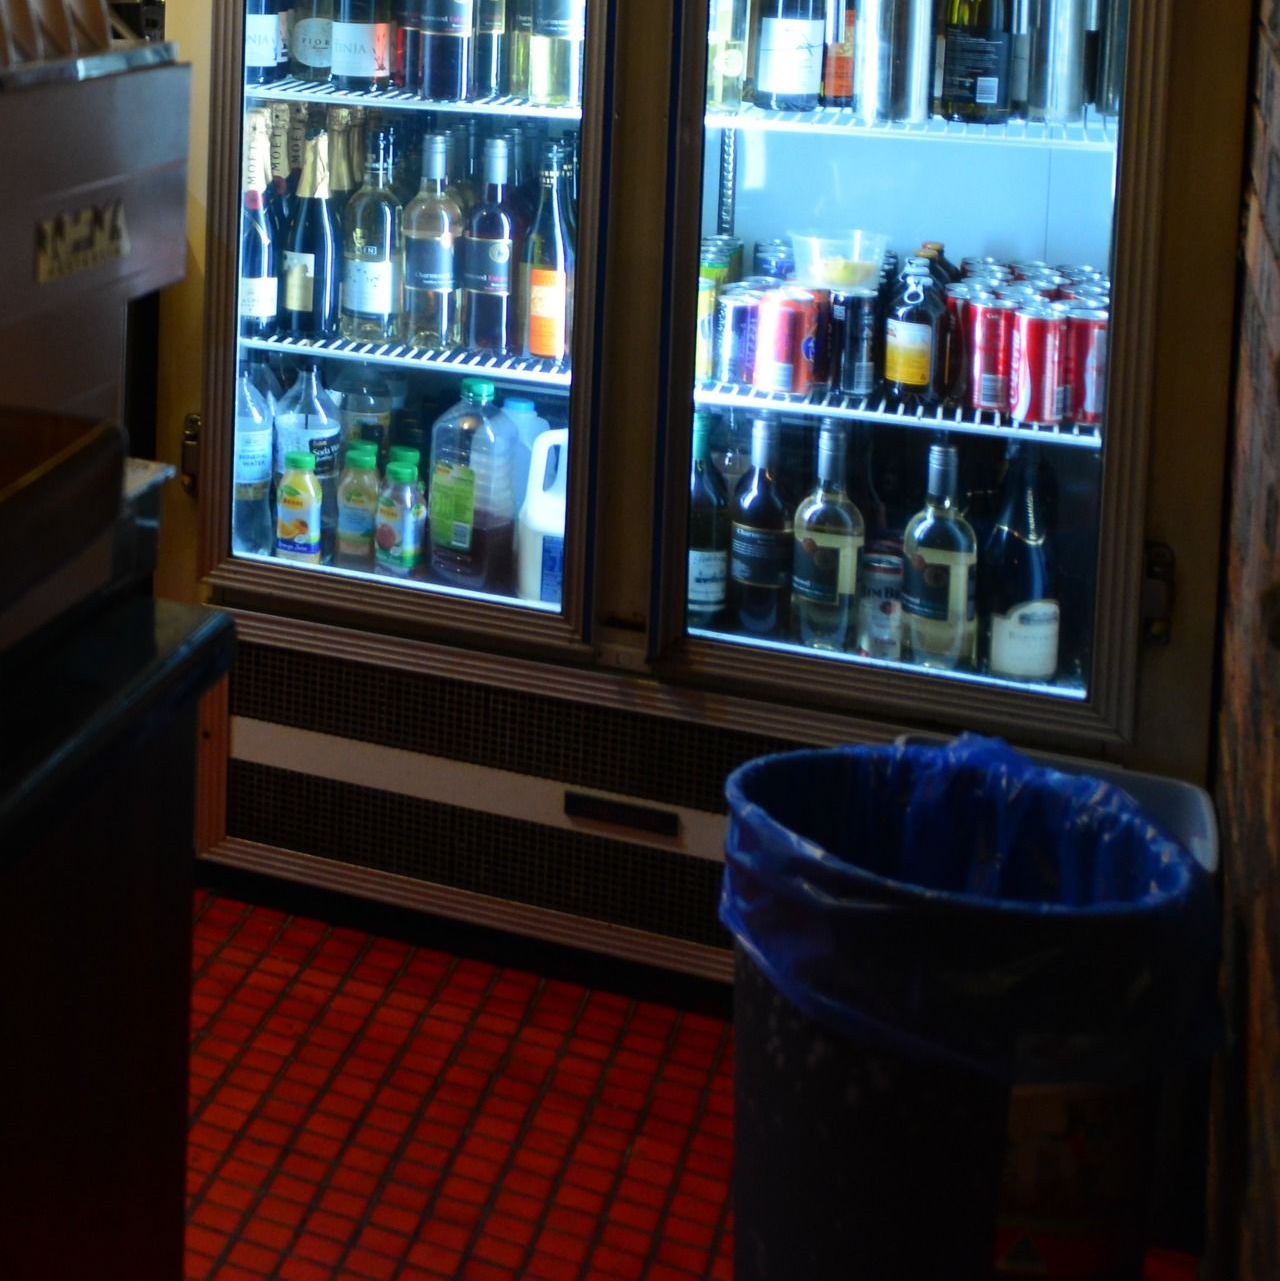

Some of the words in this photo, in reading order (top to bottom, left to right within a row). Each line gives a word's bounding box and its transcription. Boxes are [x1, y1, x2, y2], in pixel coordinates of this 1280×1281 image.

[302, 37, 330, 46] FIOR
[312, 444, 330, 457] Soda
[242, 459, 266, 467] WATER
